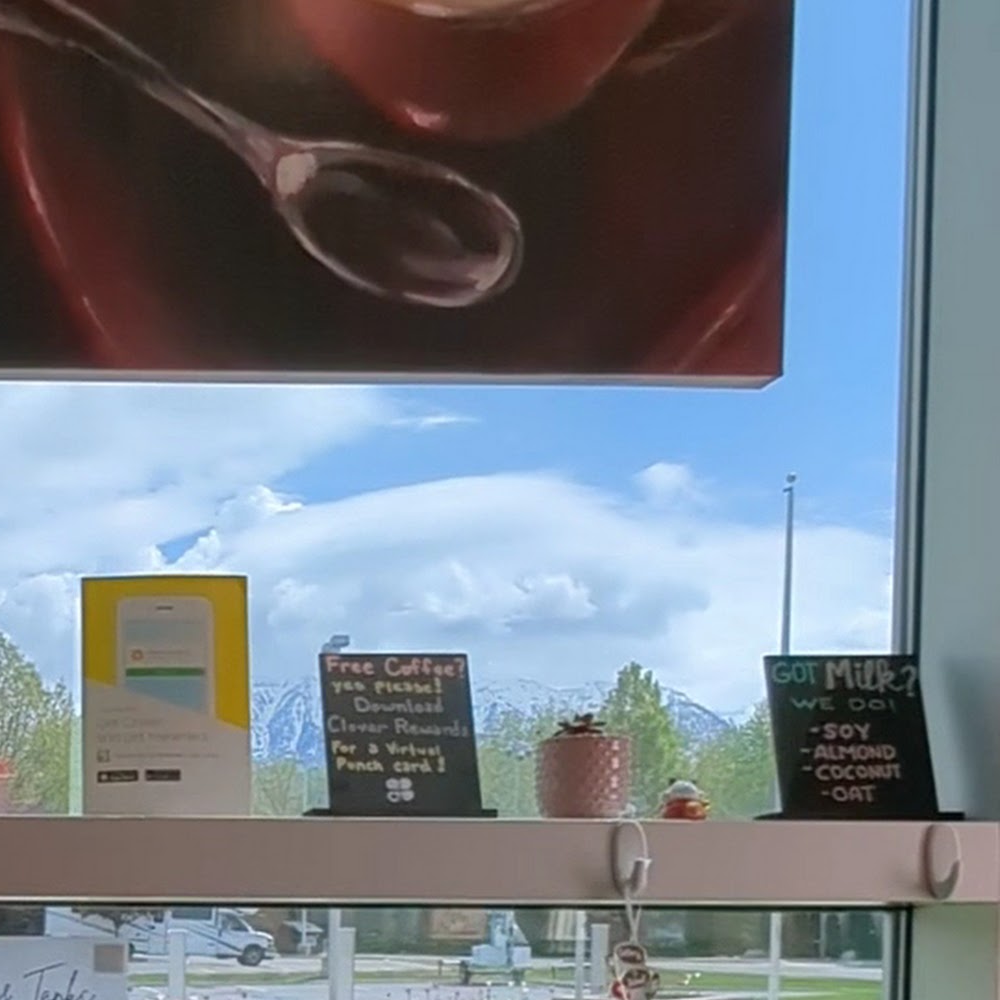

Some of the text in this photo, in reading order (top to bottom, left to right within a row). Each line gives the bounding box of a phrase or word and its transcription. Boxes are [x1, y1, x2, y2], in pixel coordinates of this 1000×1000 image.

[326, 656, 465, 678] Free Coffee?
[771, 659, 916, 697] GOT Milk?
[354, 696, 444, 713] Download
[394, 718, 469, 737] Rewards
[368, 743, 379, 754] a
